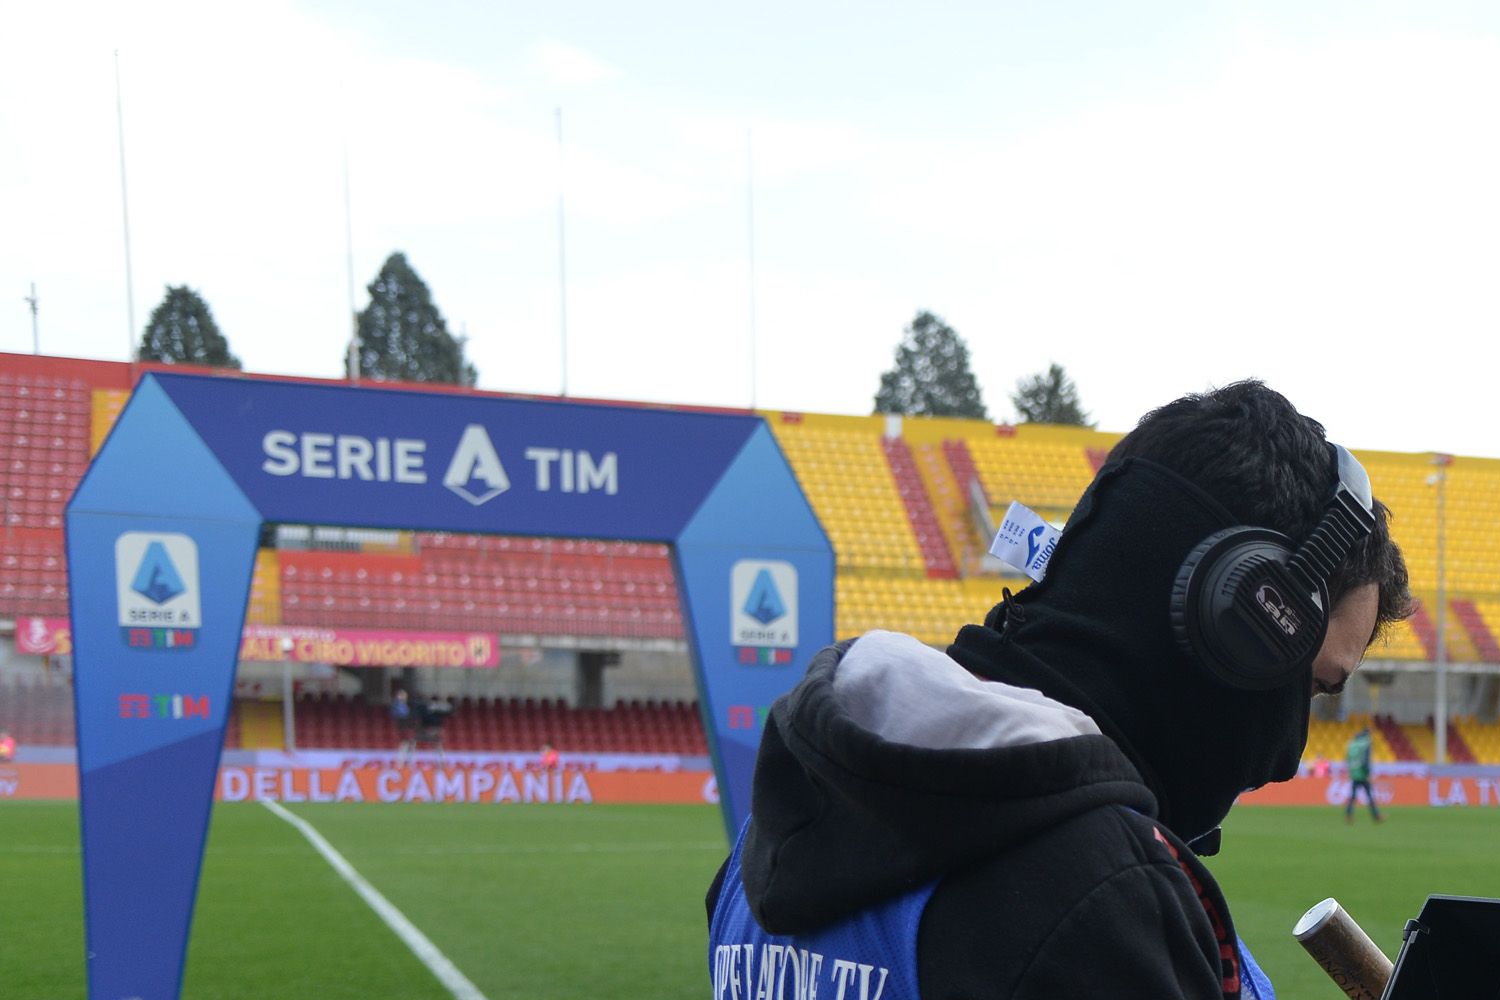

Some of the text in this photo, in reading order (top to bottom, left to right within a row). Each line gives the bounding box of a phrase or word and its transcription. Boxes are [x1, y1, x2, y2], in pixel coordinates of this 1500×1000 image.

[262, 423, 618, 506] SERIE A TIM
[1032, 537, 1056, 570] Joma
[129, 609, 174, 622] SERIE
[153, 629, 195, 648] TIM
[300, 638, 354, 665] CIRO
[355, 640, 466, 667] VIGORITO
[153, 693, 210, 720] TIM
[221, 777, 593, 805] DELLA CAMPANIA
[1429, 777, 1468, 807] LA
